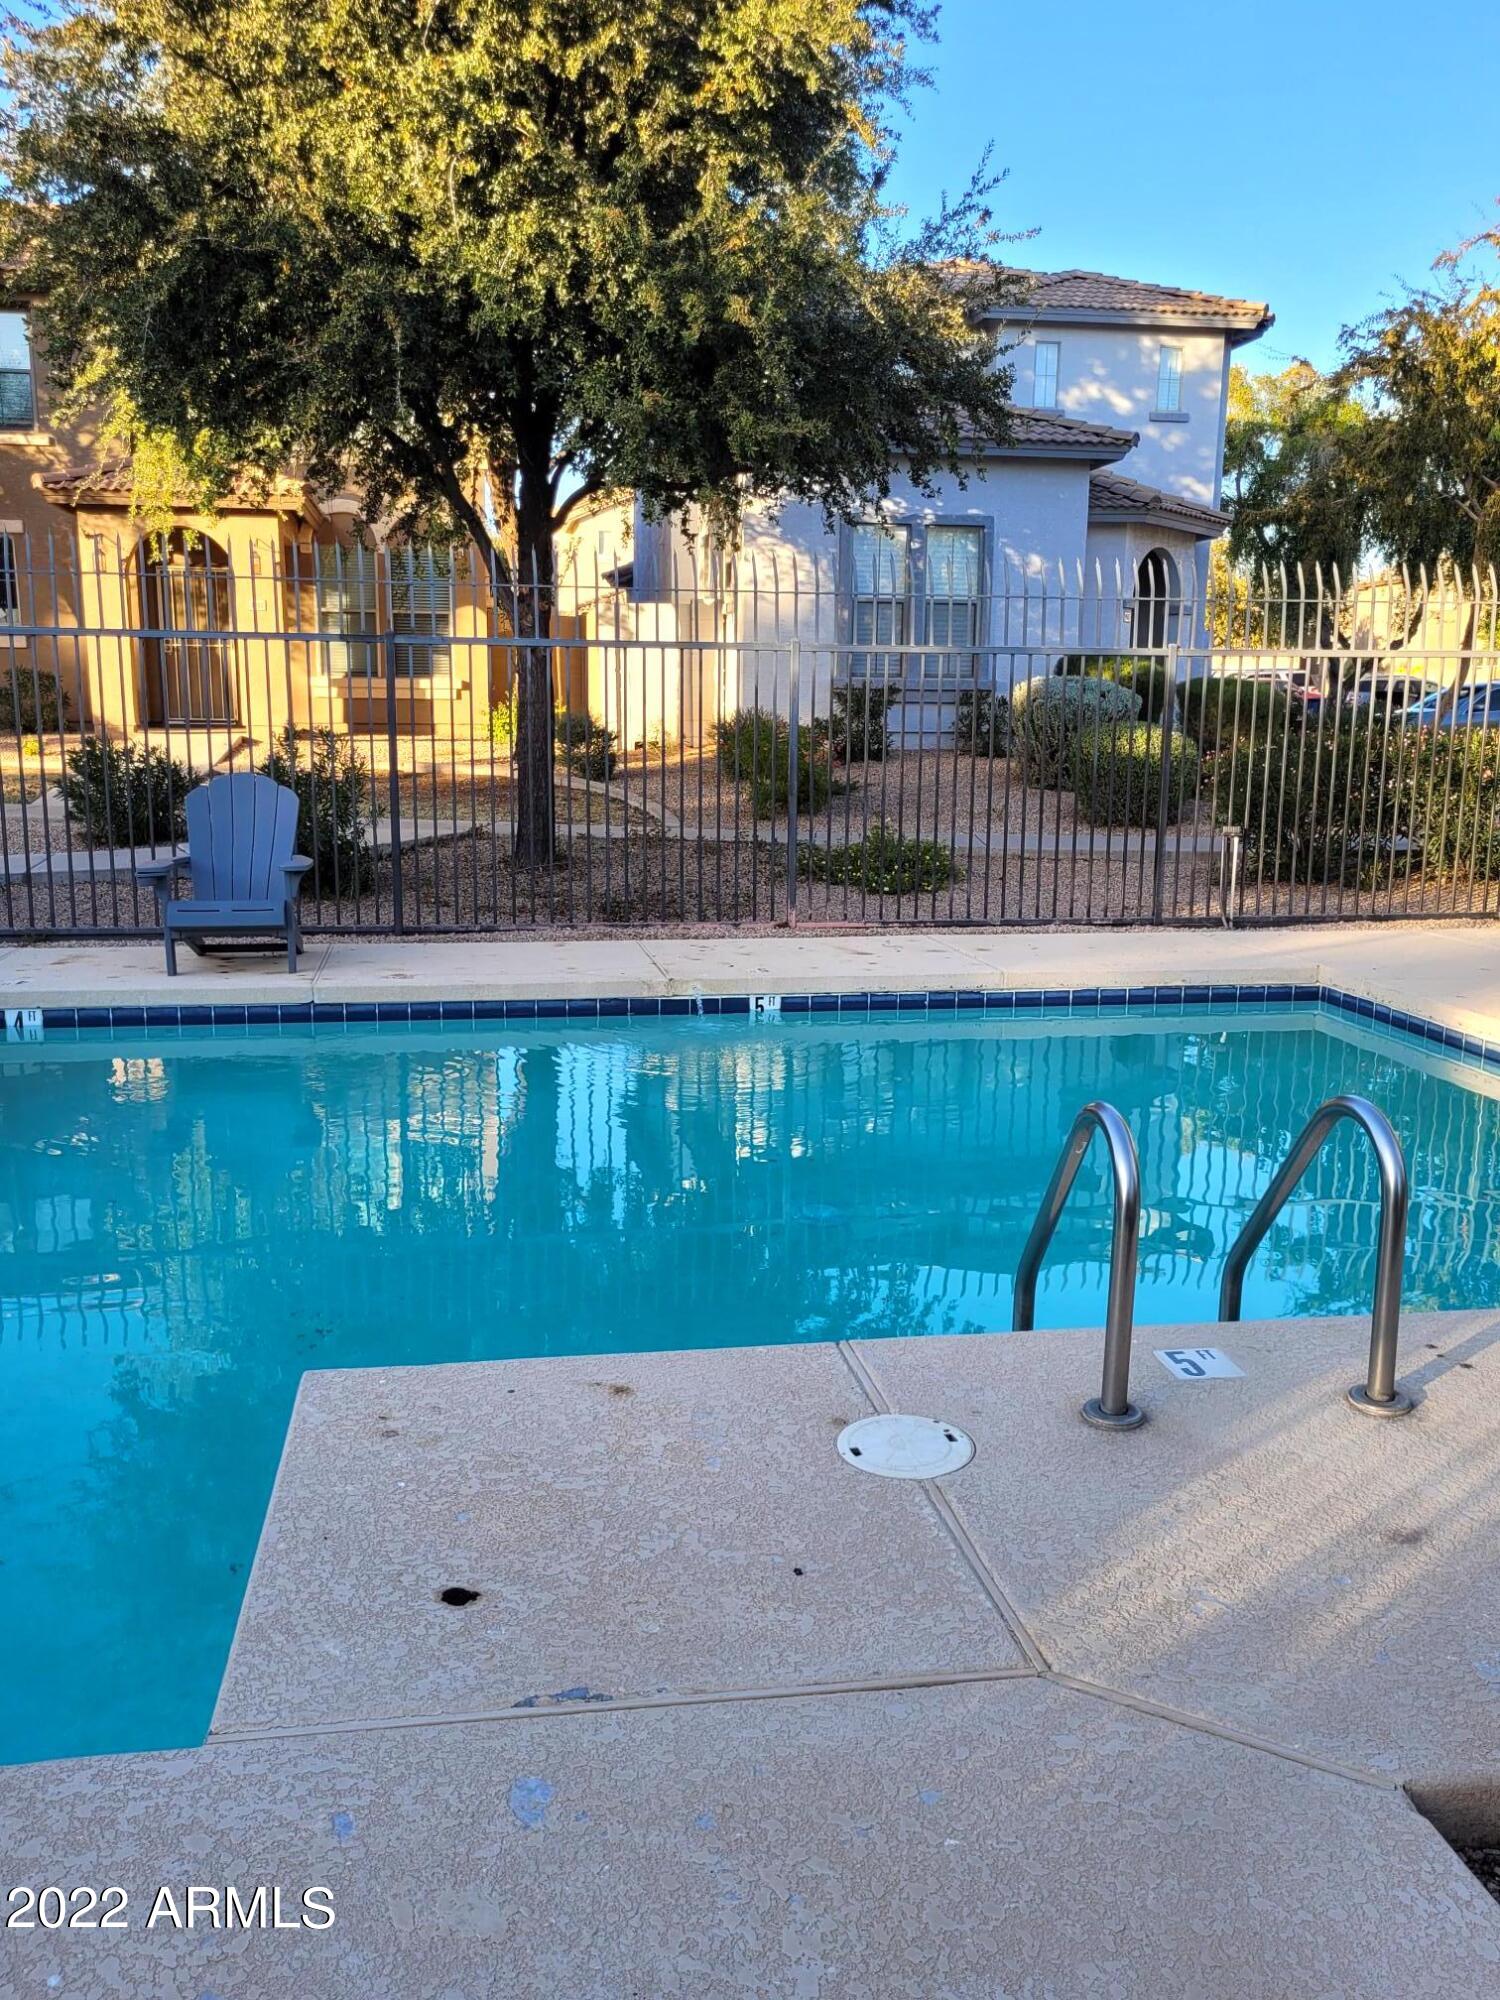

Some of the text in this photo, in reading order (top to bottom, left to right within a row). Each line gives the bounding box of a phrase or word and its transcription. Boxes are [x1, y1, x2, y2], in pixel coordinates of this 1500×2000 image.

[755, 996, 765, 1013] 5
[1163, 1349, 1217, 1377] 5 FT
